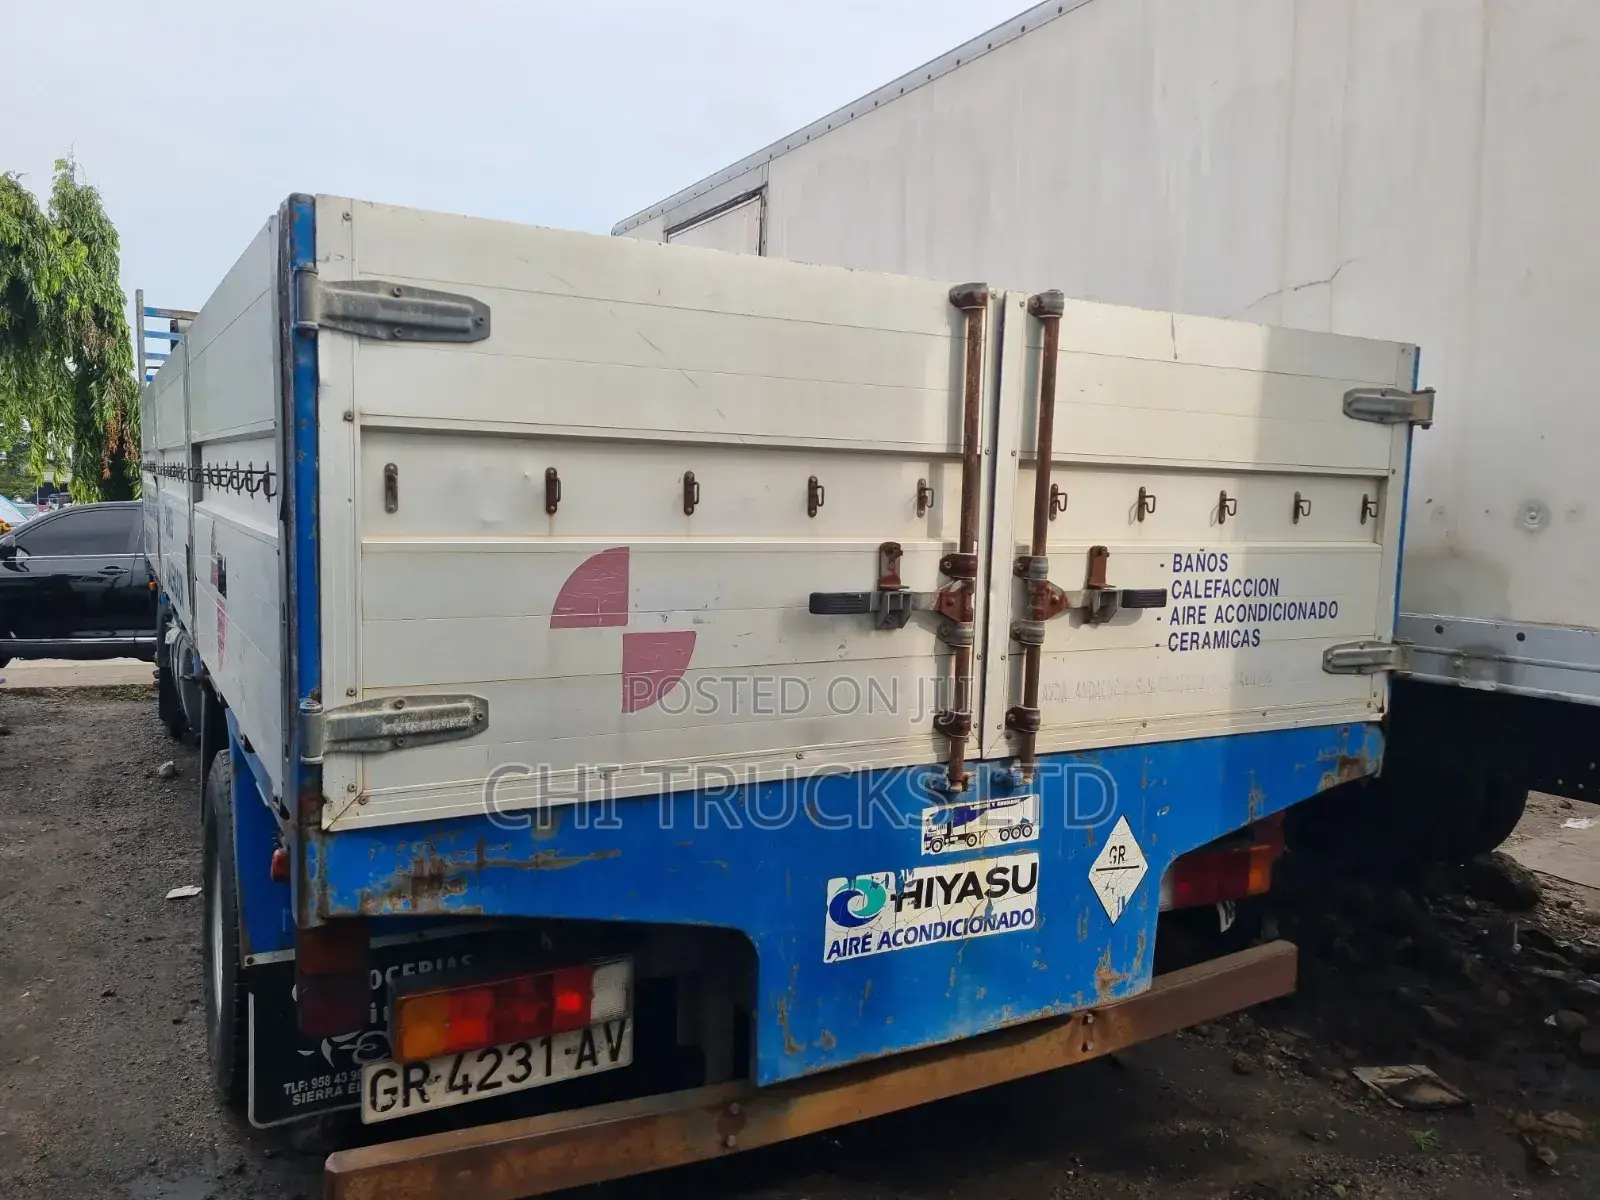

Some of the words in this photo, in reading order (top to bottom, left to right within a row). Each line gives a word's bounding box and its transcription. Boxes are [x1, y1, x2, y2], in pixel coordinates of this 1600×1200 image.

[1172, 548, 1229, 573] BAÑOS
[1170, 578, 1279, 600] CALEFACCION
[1169, 604, 1207, 626] AIRE
[1213, 600, 1339, 624] ACONDICIONADO
[1168, 628, 1261, 653] CERAMICAS
[1109, 845, 1126, 865] GR
[890, 862, 1038, 913] HIYASU
[826, 931, 872, 960] AIRE
[878, 907, 1035, 947] ACONDICIONADO
[311, 1075, 332, 1089] 958
[334, 1071, 347, 1084] 43
[291, 1084, 344, 1106] SIERRA
